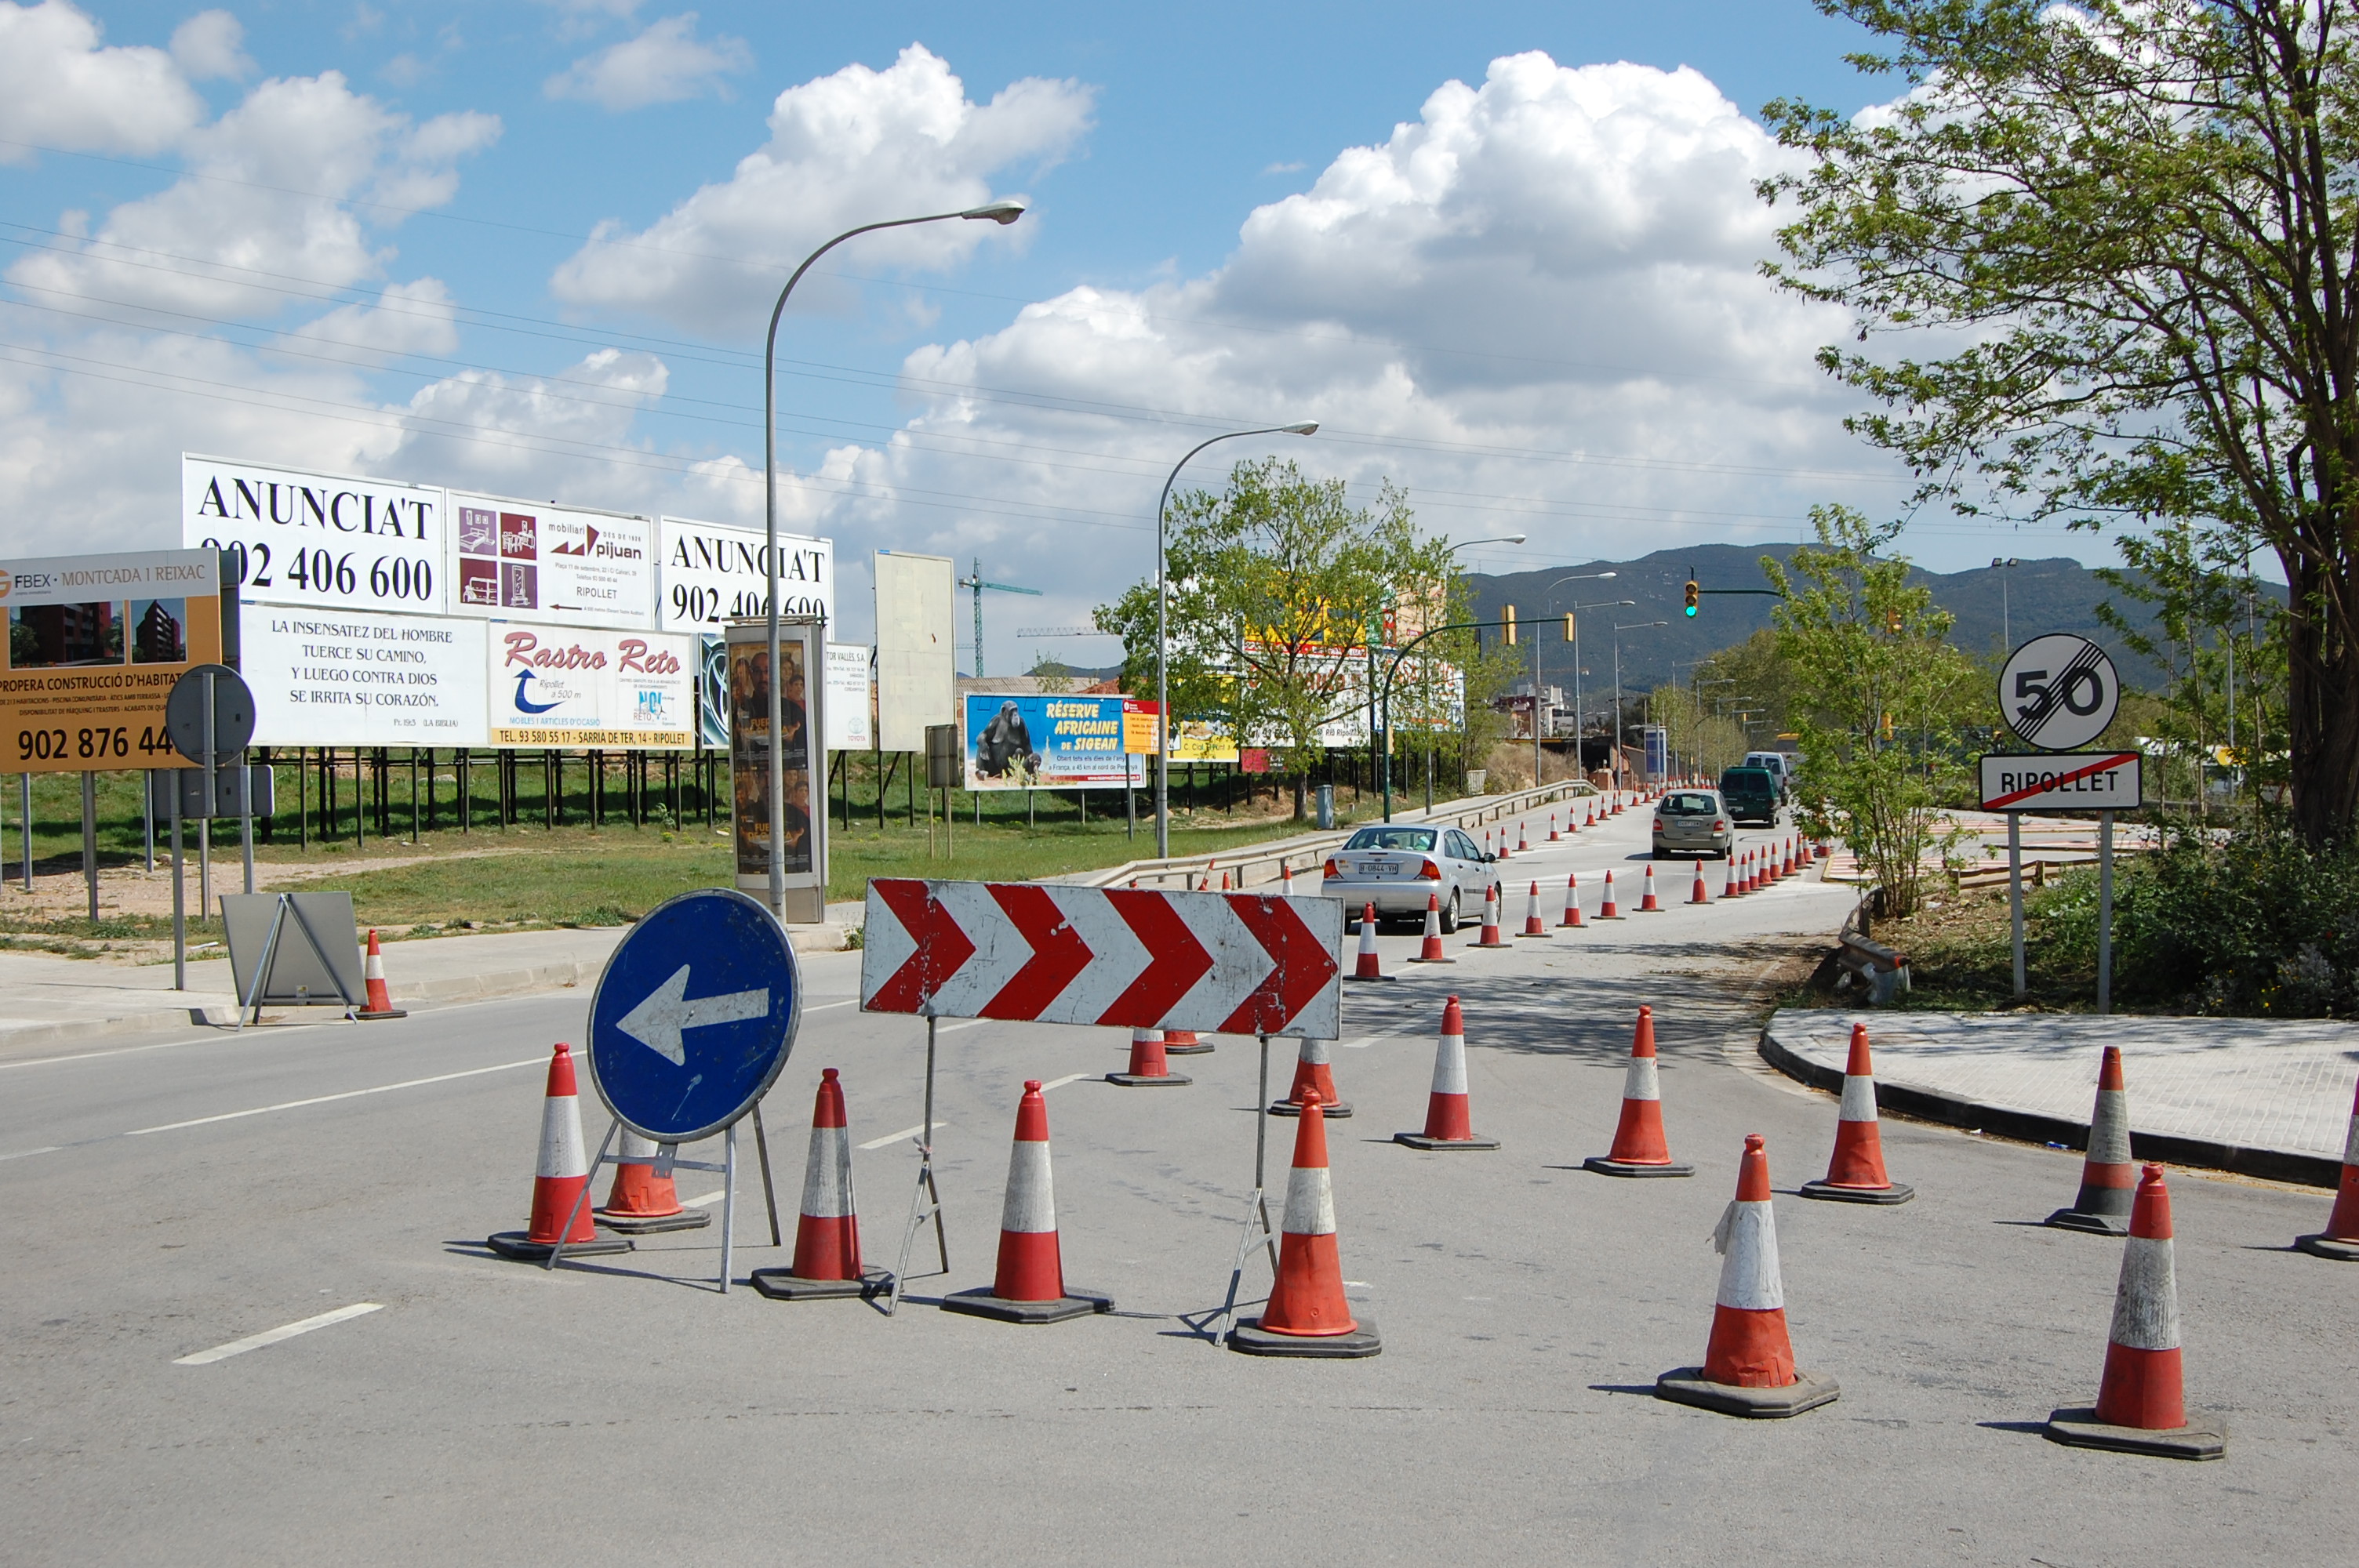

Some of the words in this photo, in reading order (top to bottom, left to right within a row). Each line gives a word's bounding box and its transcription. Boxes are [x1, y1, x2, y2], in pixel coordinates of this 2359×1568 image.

[197, 474, 433, 540] ANUNCIA'T
[548, 523, 585, 535] mobiliari
[596, 542, 642, 560] pijuan
[671, 534, 824, 583] ANUNCIA'T
[15, 574, 51, 588] FBEX
[61, 568, 142, 586] MONTCADA
[155, 564, 205, 581] REIXAC
[287, 546, 356, 594] 406
[370, 555, 432, 601] 600
[576, 586, 617, 599] RIPOLLET
[673, 583, 720, 622] 902
[272, 620, 289, 633] LA
[293, 621, 369, 639] INSENSATEZ
[374, 627, 398, 641] DEL
[402, 629, 453, 643] HOMBRE
[302, 644, 352, 660] TUERCE
[356, 648, 373, 661] SU
[376, 649, 427, 665] CAMINO,
[503, 631, 608, 670] Rastro
[618, 639, 681, 675] Reto
[47, 673, 122, 691] CONSTRUCCIÓ
[291, 667, 300, 680] Y
[304, 668, 349, 681] LUEGO
[352, 670, 405, 684] CONTRA
[409, 673, 438, 685] DIOS
[290, 690, 307, 702] SE
[311, 691, 351, 705] IRRITA
[355, 692, 372, 706] SU
[376, 693, 438, 707] CORAZÓN.
[558, 690, 572, 699] 500
[2016, 666, 2103, 720] 50
[1046, 700, 1100, 718] RÉSERVE
[509, 717, 534, 725] MOBLES
[540, 717, 569, 726] ARTICLES
[1054, 720, 1118, 735] AFRICAINE
[18, 728, 68, 760] 902
[78, 727, 129, 758] 876
[138, 726, 182, 756] 44
[500, 730, 516, 742] TEL.
[519, 730, 529, 742] 93
[532, 731, 547, 743] 580
[549, 731, 559, 743] 55
[562, 731, 570, 743] 17
[609, 732, 618, 744] DE
[620, 732, 636, 745] TER,
[638, 733, 647, 744] 14
[653, 733, 685, 745] RIPOLLET
[1061, 742, 1071, 750] DE
[1074, 738, 1118, 751] SIGEAN
[2001, 771, 2119, 793] RIPOLLET
